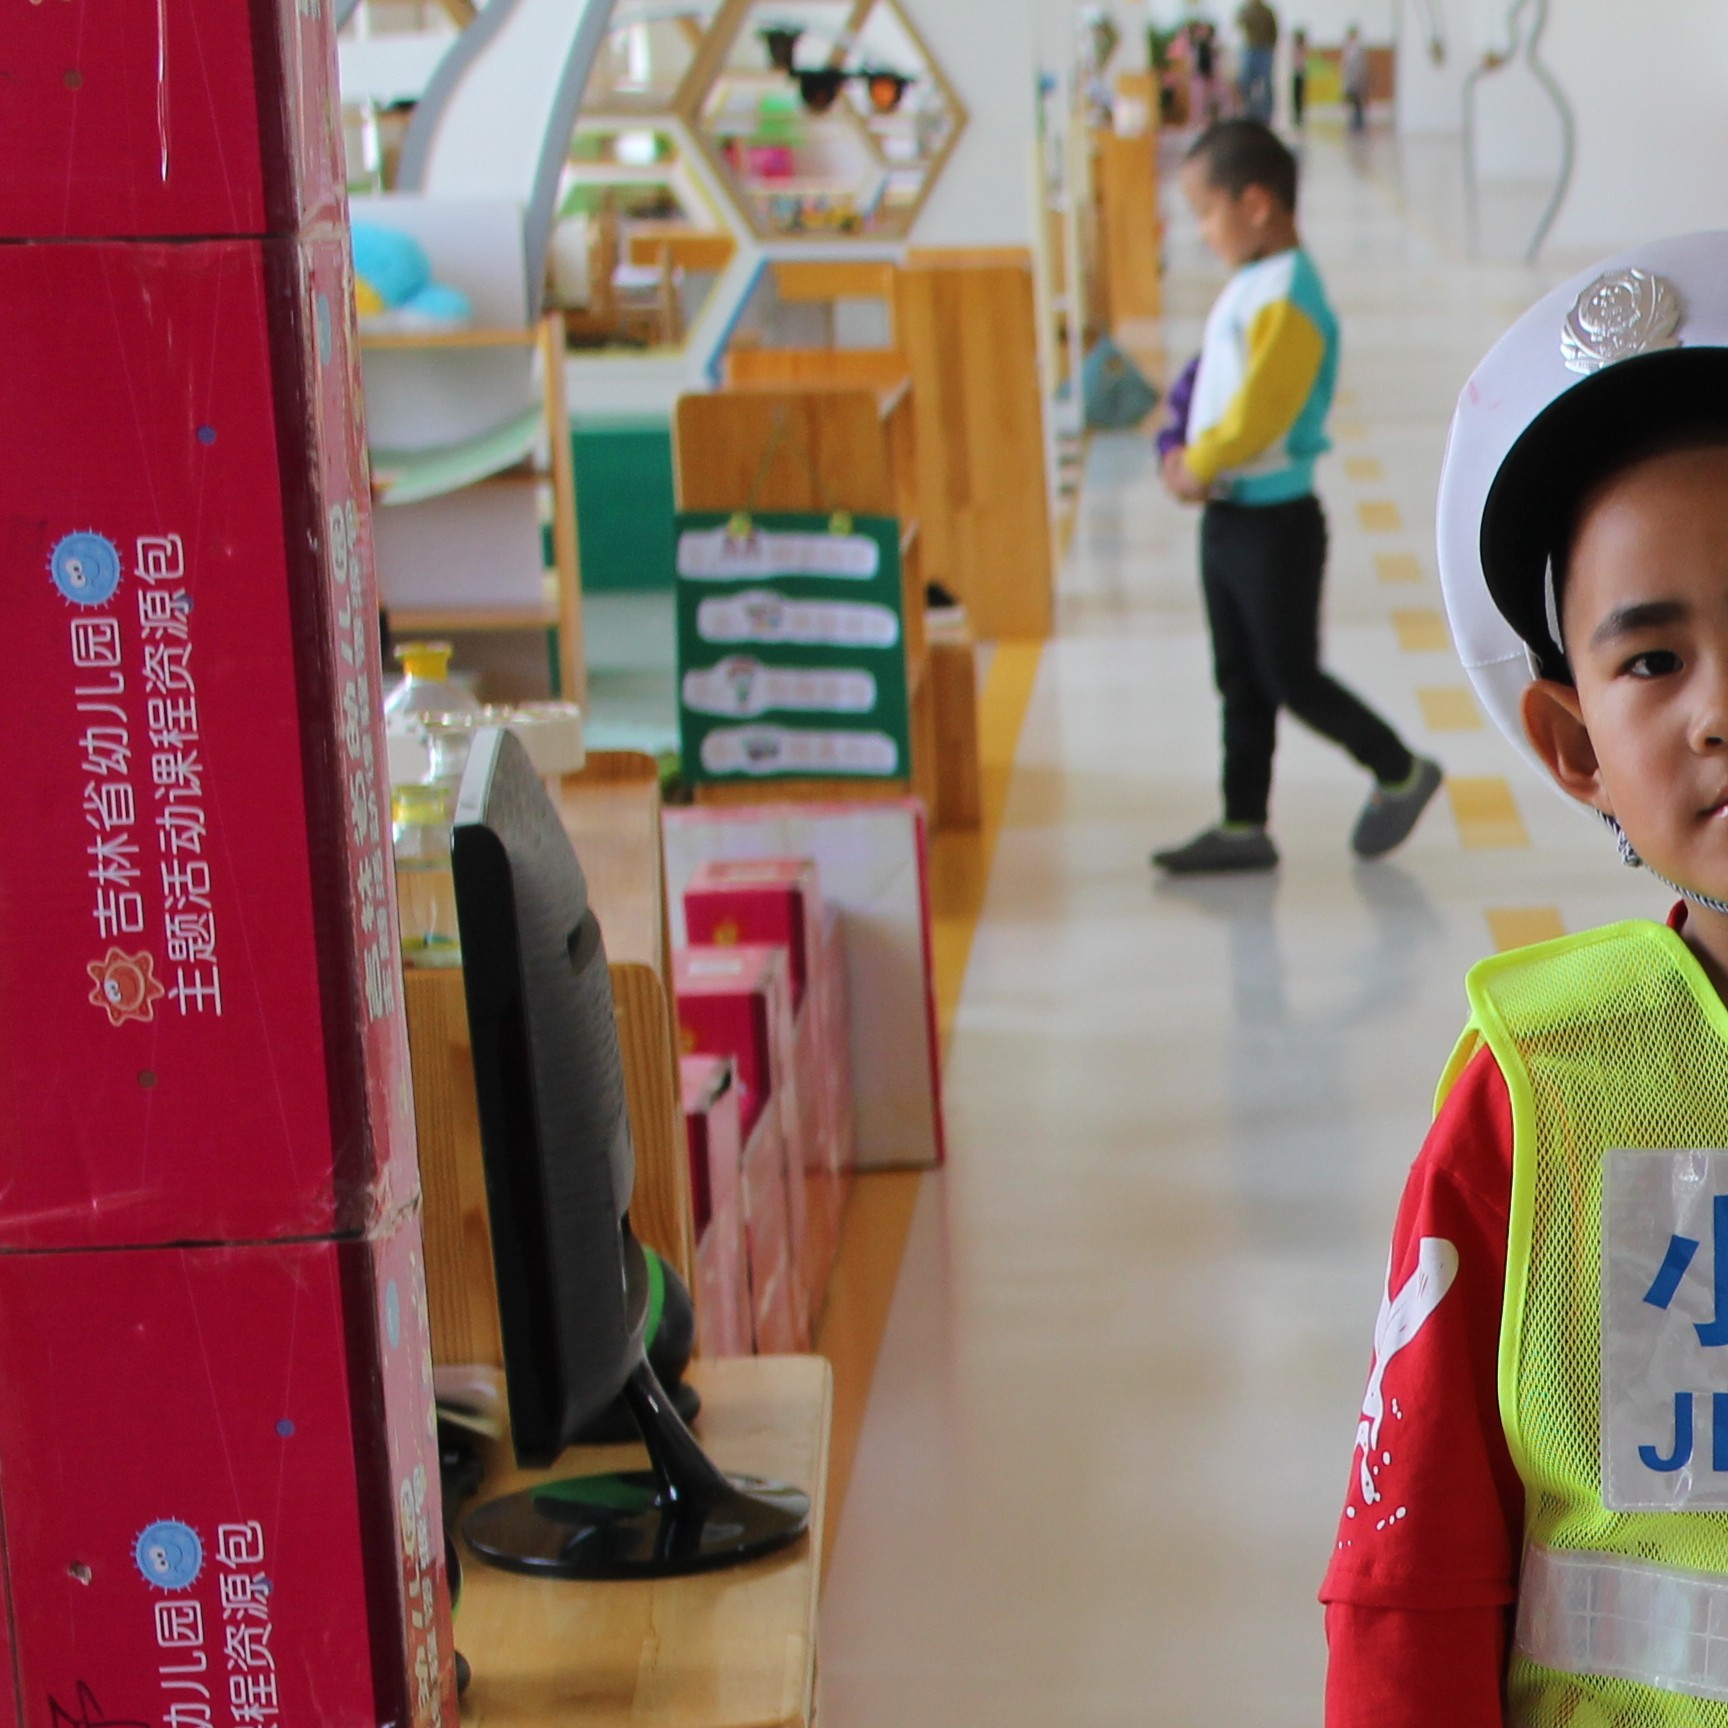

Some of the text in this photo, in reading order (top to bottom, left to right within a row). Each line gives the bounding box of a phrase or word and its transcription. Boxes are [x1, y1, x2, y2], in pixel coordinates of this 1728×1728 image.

[72, 614, 148, 940] 吉林省幼儿园
[136, 533, 226, 1018] 主题活动课程资源包
